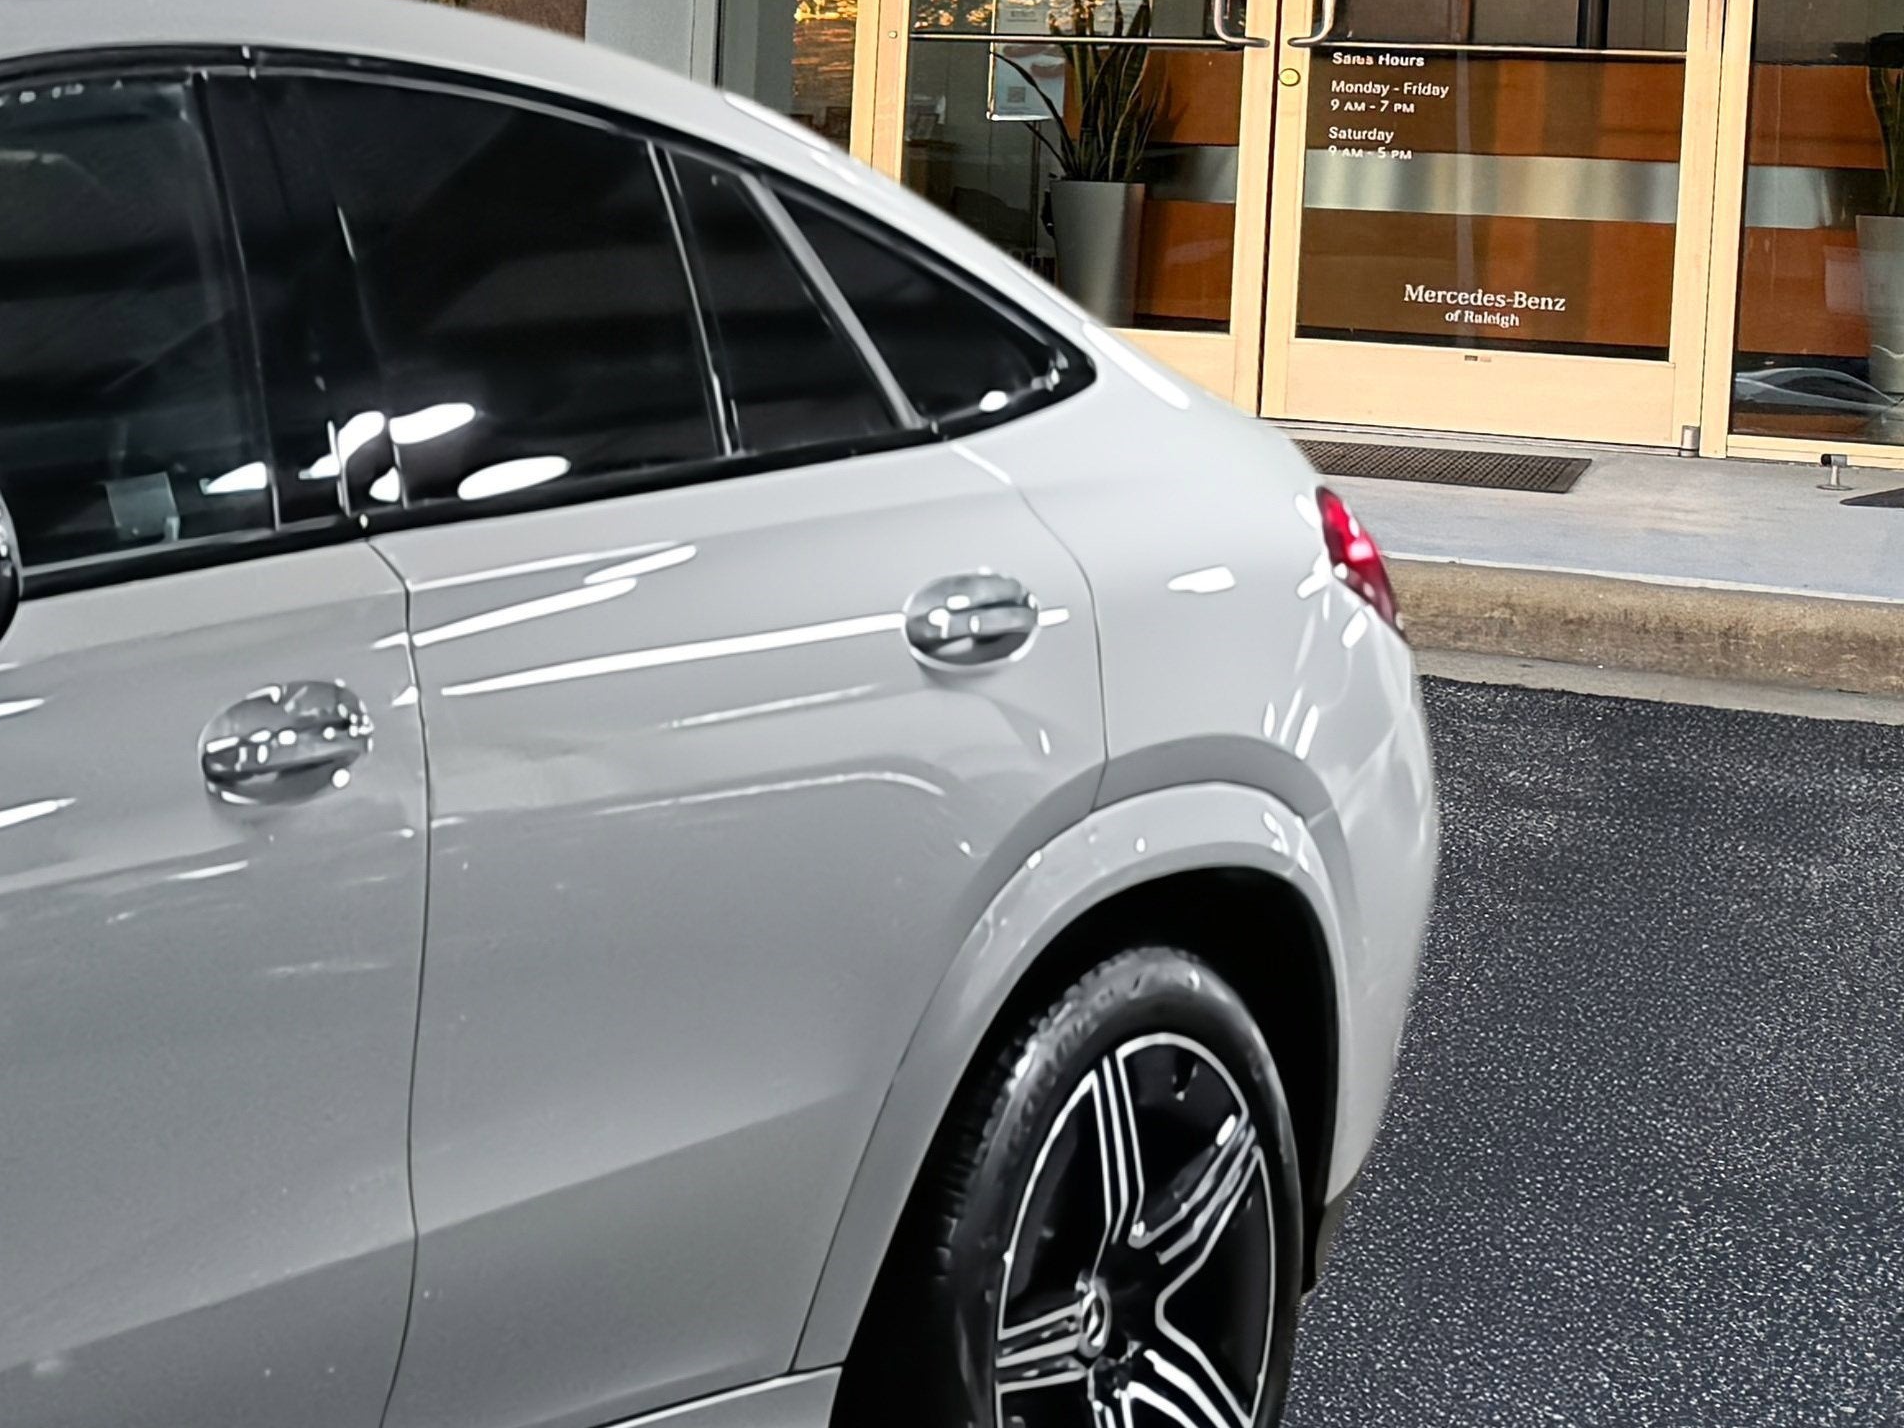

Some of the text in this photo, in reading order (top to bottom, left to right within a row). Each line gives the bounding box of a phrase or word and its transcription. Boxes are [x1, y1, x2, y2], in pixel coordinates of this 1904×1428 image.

[1378, 53, 1425, 67] Hours
[1331, 79, 1390, 97] Monday
[1403, 82, 1449, 99] Friday
[1330, 98, 1340, 111] 9
[1344, 101, 1366, 112] AM
[1380, 100, 1389, 112] 7
[1393, 103, 1415, 113] PM
[1328, 126, 1394, 144] Saturday
[1328, 145, 1337, 157] 9
[1342, 148, 1364, 158] AM
[1377, 146, 1386, 158] 5
[1391, 150, 1412, 159] PM
[1403, 284, 1566, 311] Mercedes-Benz
[1445, 310, 1520, 329] of Raleigh
